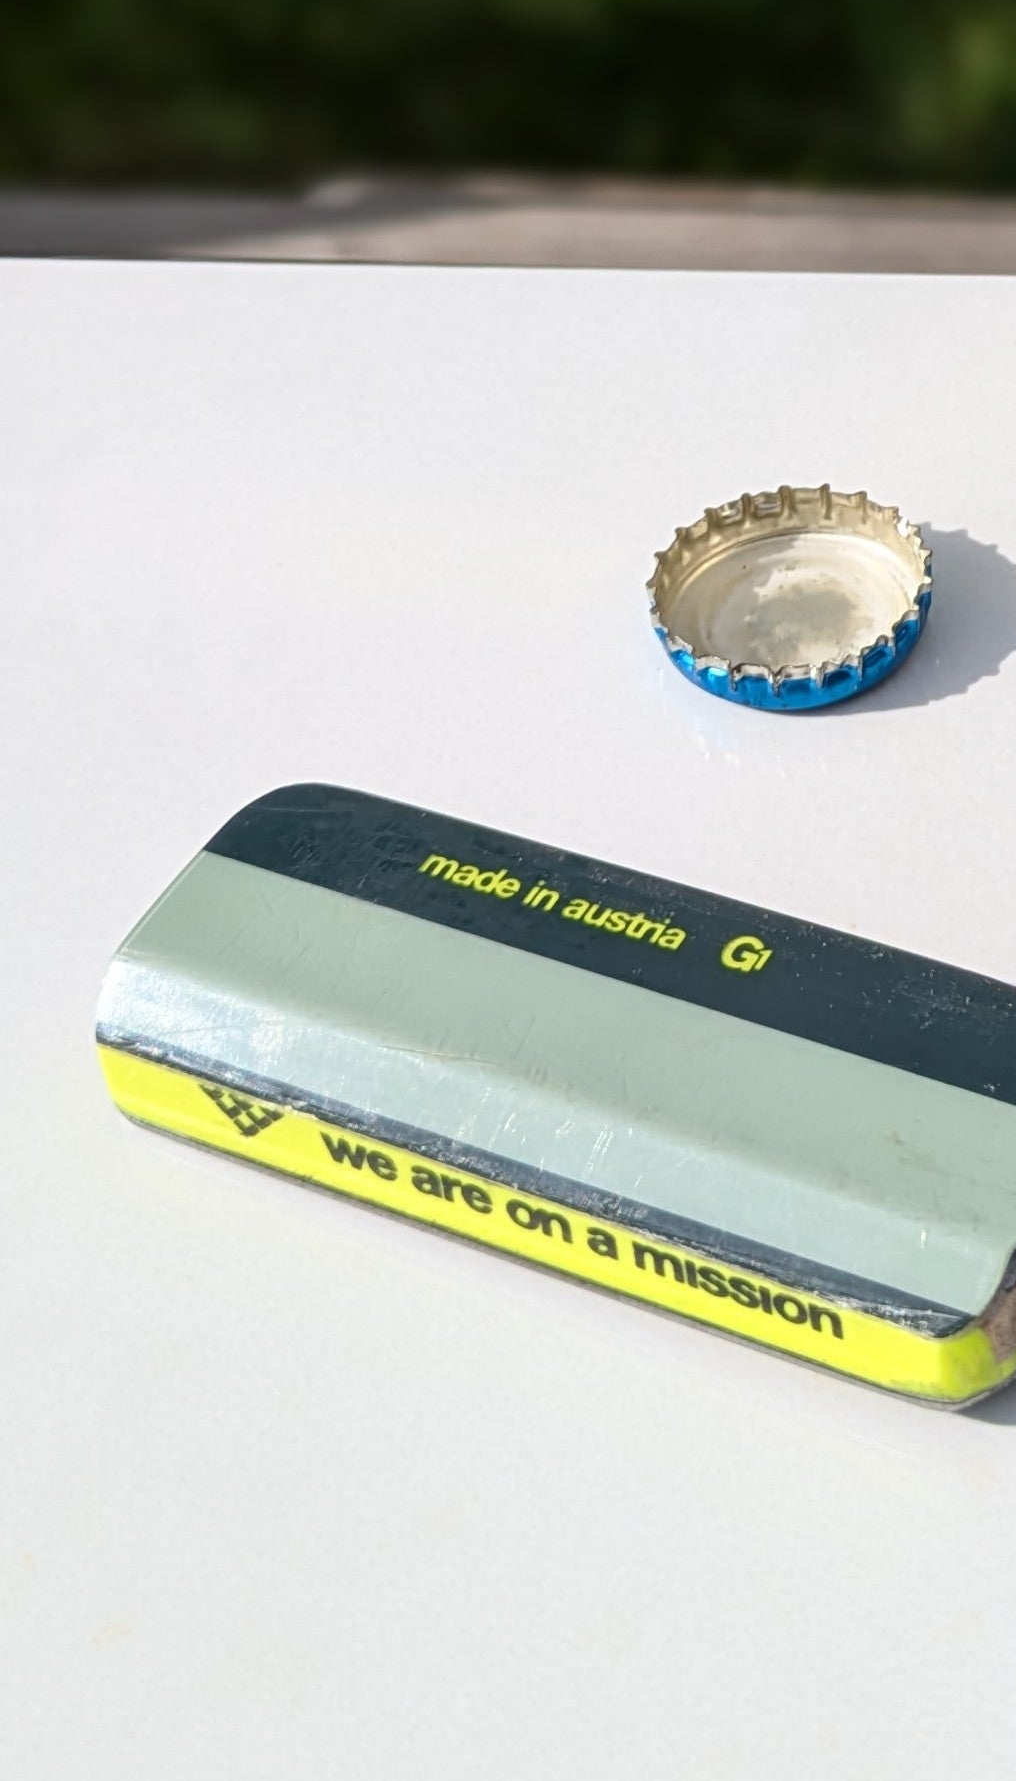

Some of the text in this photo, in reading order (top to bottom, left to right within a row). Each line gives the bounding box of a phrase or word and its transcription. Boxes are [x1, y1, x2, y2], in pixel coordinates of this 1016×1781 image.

[418, 854, 687, 950] made in austria
[320, 1130, 844, 1340] we are on a mission
